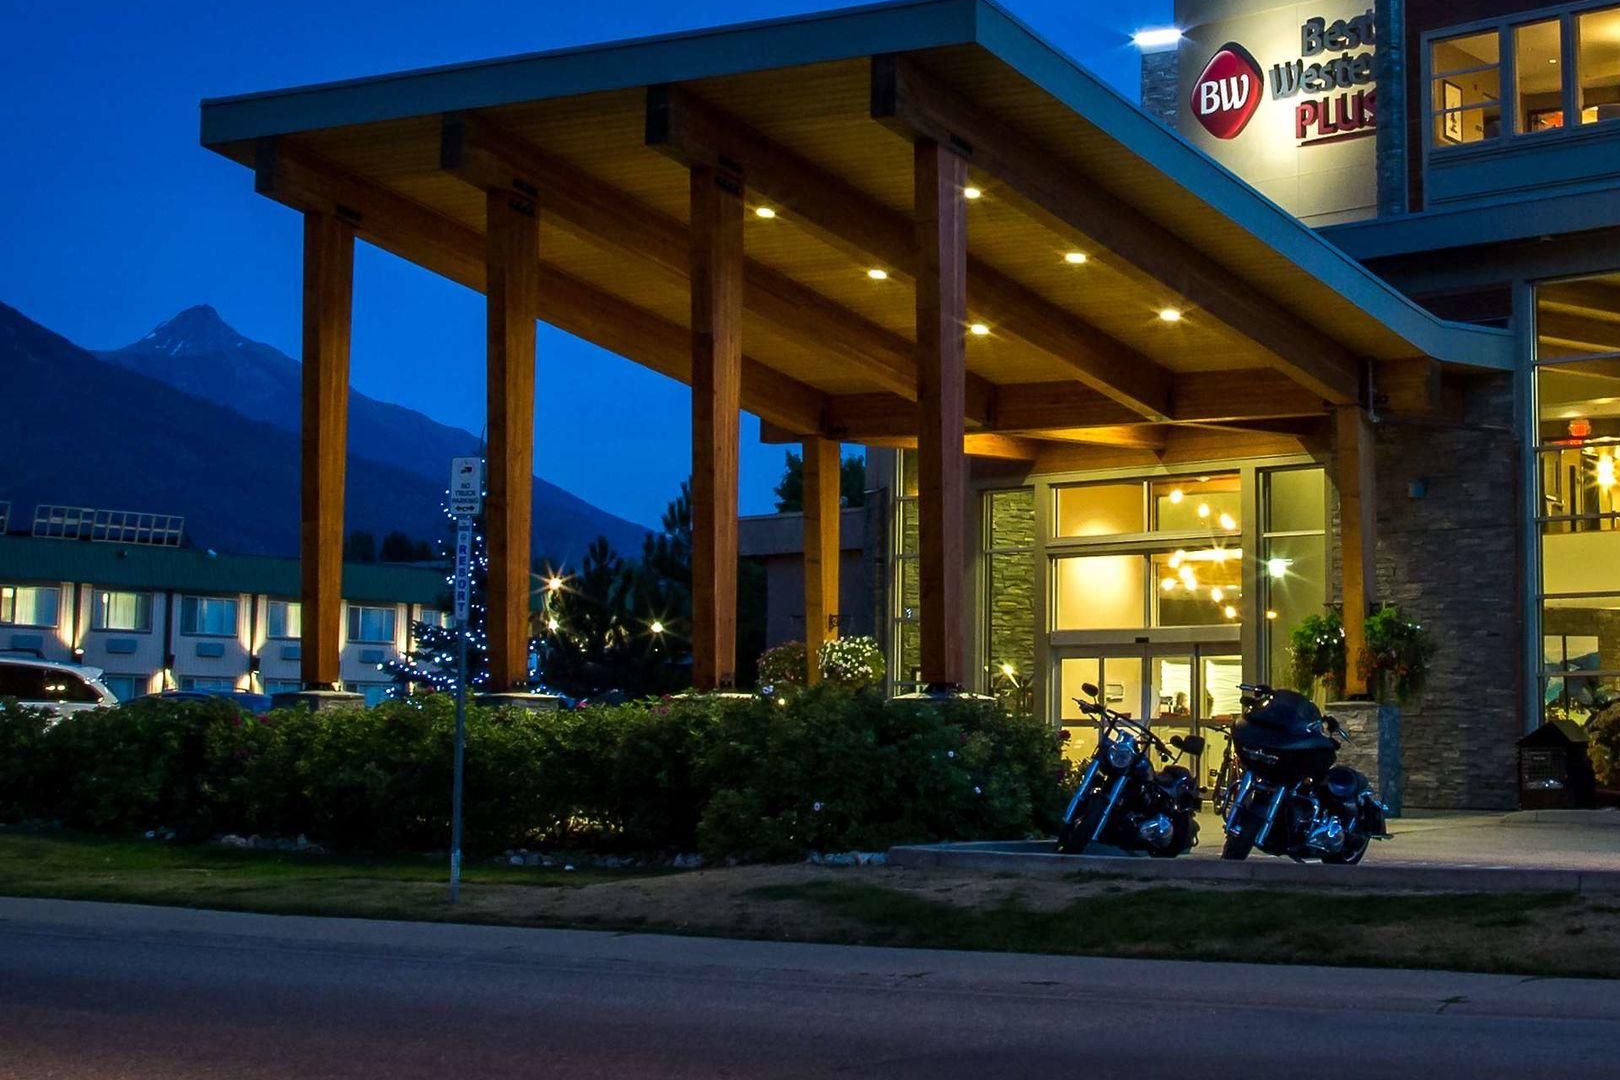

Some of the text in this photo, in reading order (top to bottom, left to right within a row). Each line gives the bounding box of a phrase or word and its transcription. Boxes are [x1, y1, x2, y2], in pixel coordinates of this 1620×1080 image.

[1301, 10, 1376, 56] Best
[1200, 74, 1249, 115] BW
[1269, 54, 1376, 100] Weste
